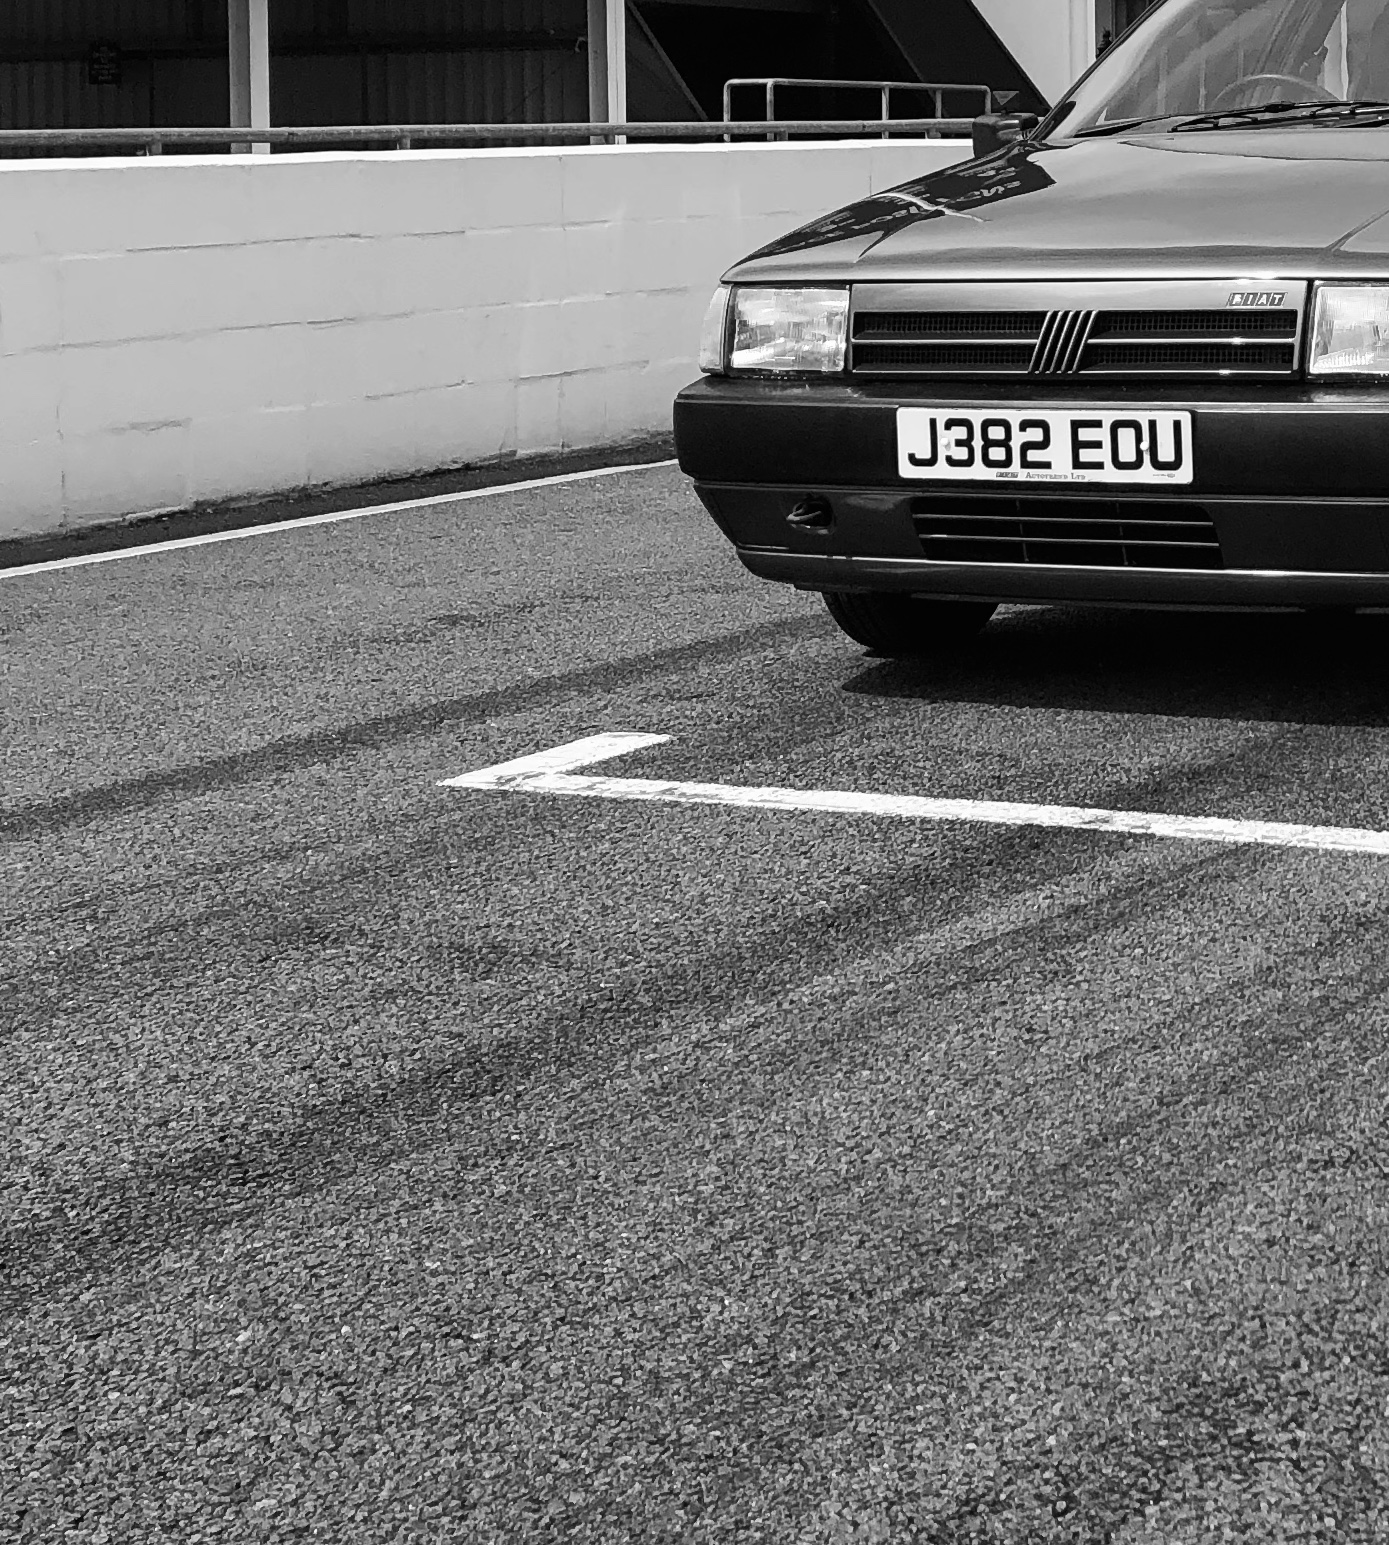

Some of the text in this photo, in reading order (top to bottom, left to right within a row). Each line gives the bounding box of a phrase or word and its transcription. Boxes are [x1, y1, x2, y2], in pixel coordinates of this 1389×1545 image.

[1230, 292, 1285, 306] FIAT
[907, 417, 1184, 471] J382 EOU
